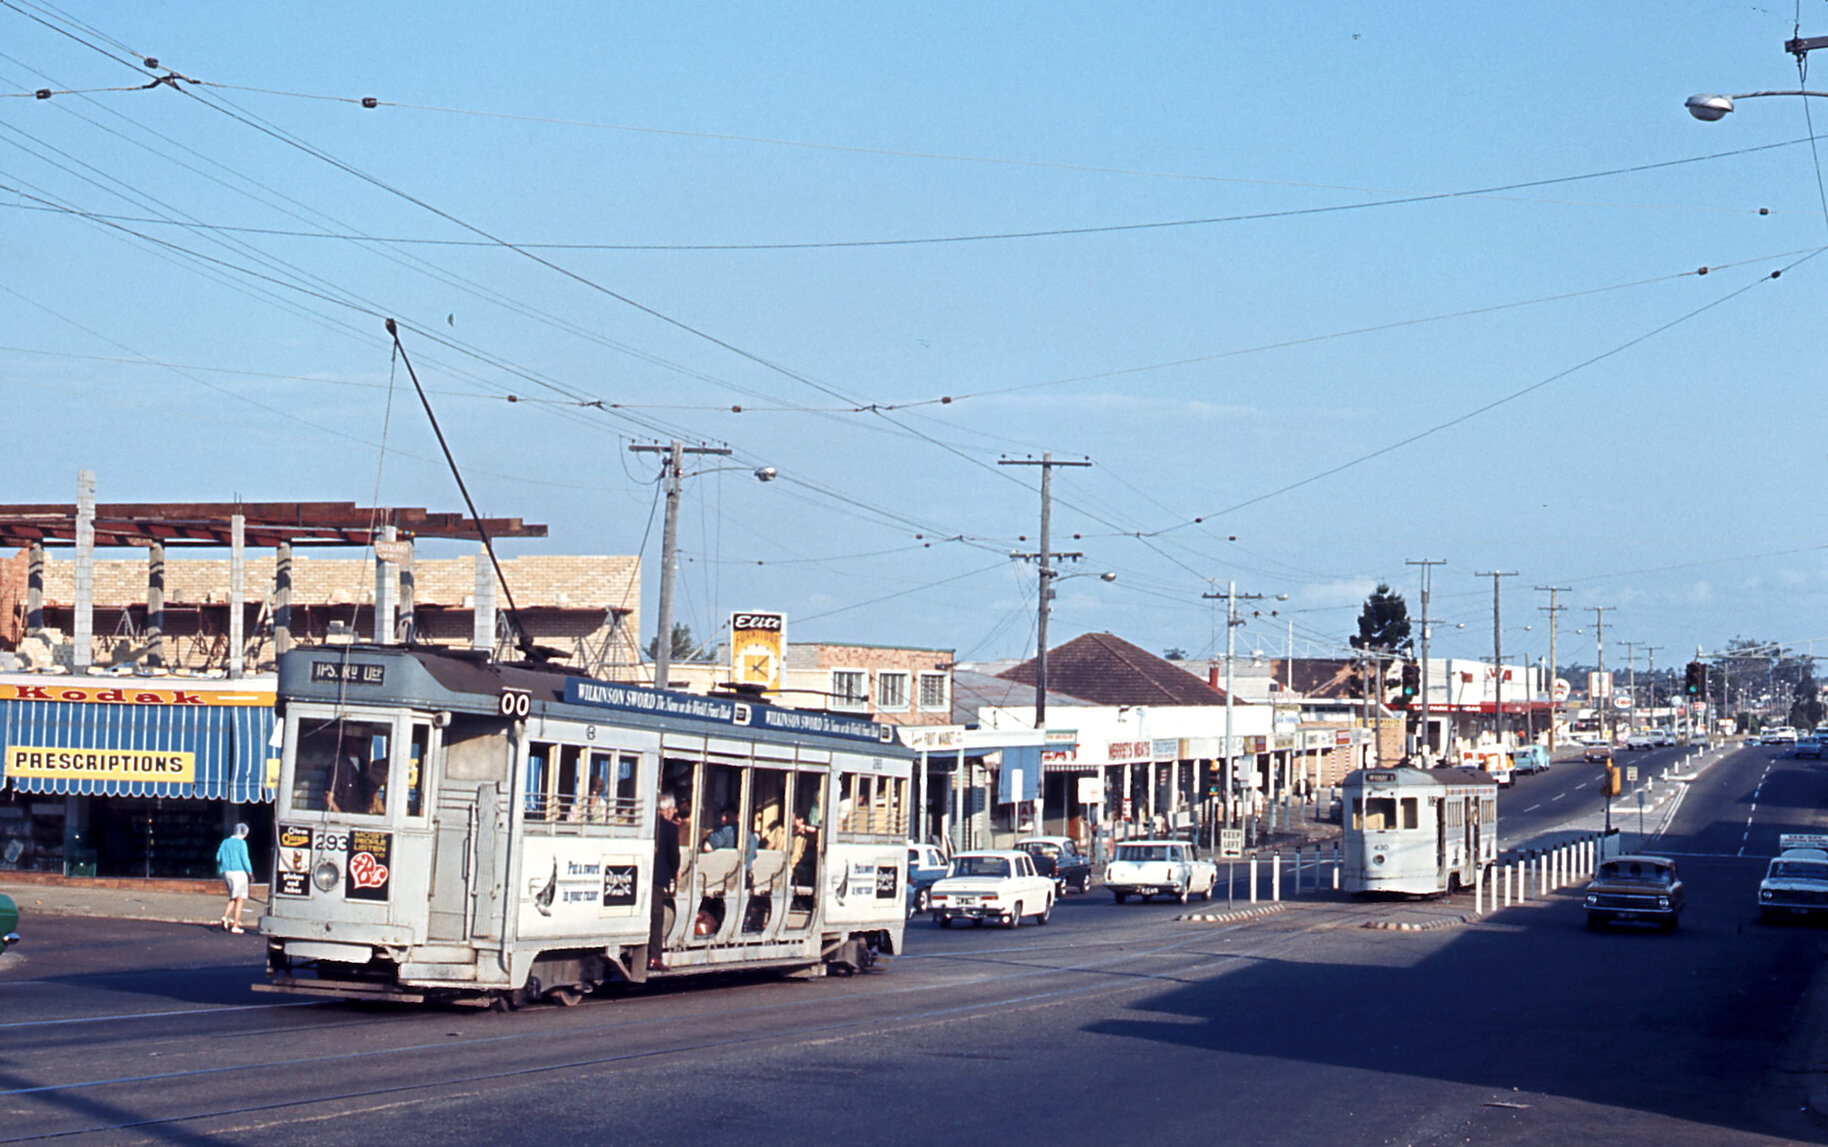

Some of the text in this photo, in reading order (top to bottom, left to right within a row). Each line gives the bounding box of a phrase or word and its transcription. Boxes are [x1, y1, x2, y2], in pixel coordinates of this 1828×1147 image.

[735, 615, 780, 628] Elite
[15, 685, 205, 704] Kodak
[578, 683, 624, 705] WILKINSON
[626, 690, 656, 710] SWORD
[502, 693, 530, 716] 00
[765, 710, 800, 728] WILKINSON
[801, 715, 822, 731] SWORD
[15, 752, 183, 772] PRESCRIPTIONS
[315, 834, 349, 851] 293
[1223, 831, 1241, 839] KEEP
[354, 845, 386, 853] LISTEN
[1223, 841, 1240, 849] LEFT
